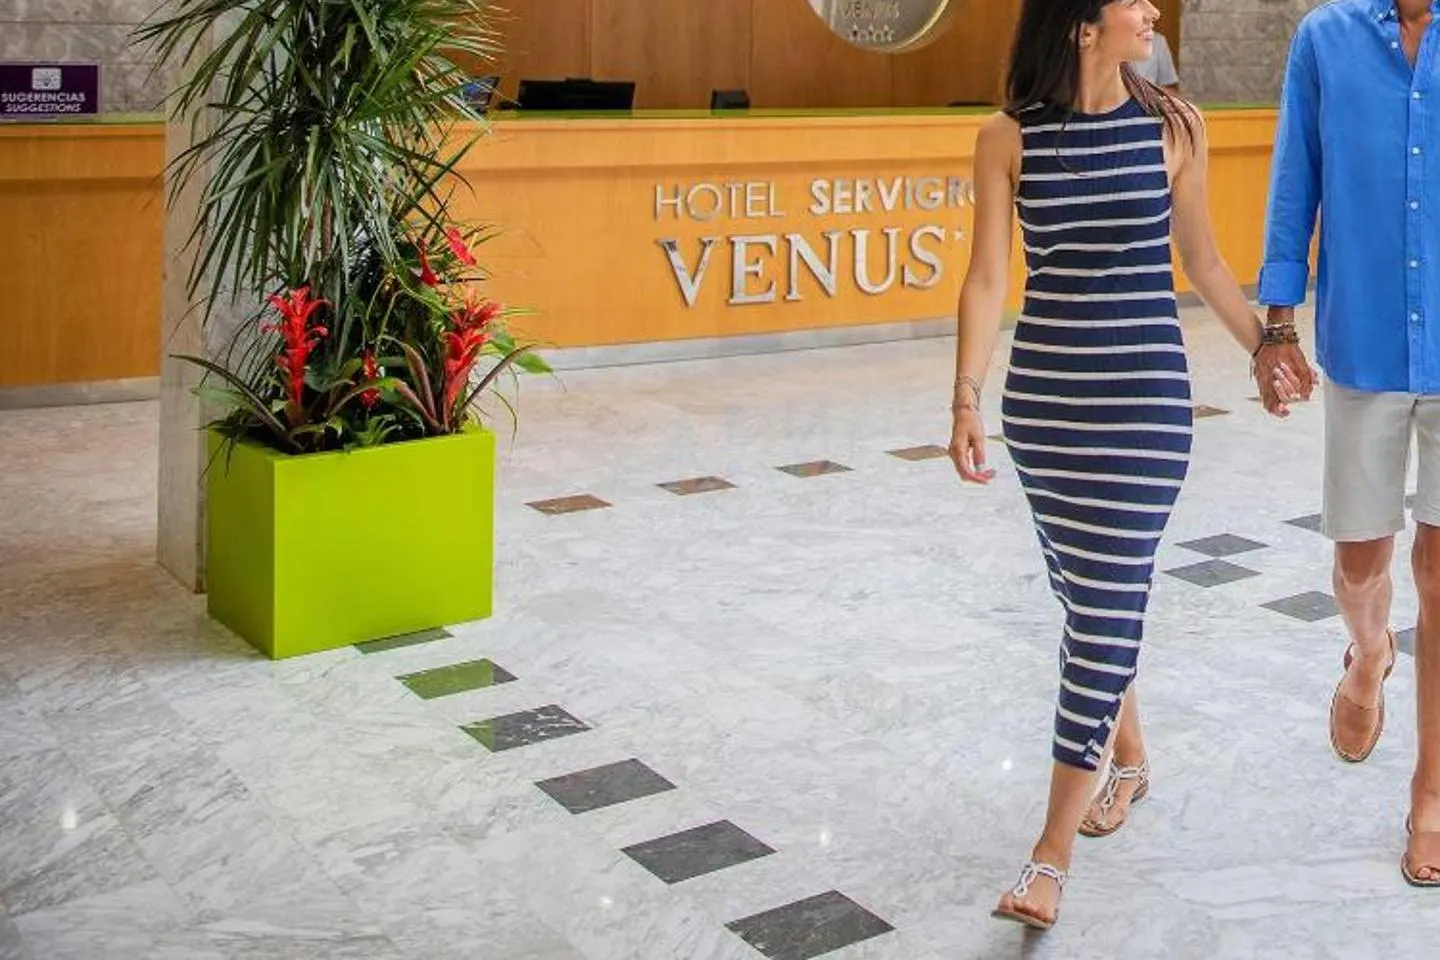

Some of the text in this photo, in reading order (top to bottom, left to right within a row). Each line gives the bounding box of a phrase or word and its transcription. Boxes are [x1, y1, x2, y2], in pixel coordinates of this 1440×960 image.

[0, 92, 87, 103] SUGERENCIAS
[5, 103, 82, 113] SUGGESTIONS
[653, 180, 785, 221] HOTEL
[656, 224, 947, 307] VENUS
